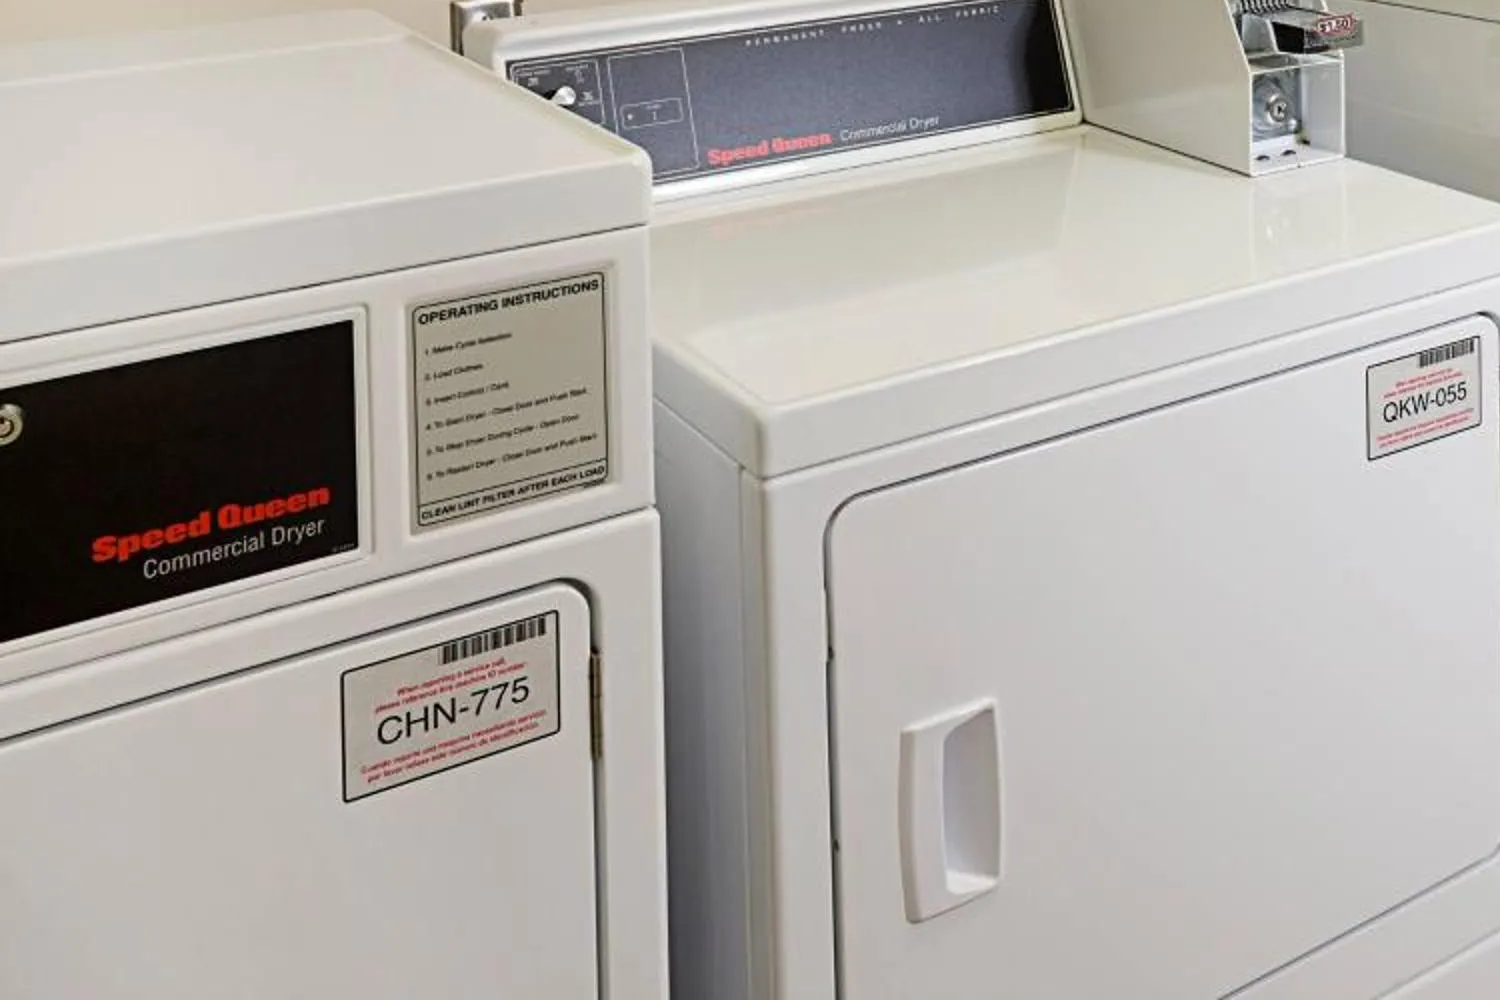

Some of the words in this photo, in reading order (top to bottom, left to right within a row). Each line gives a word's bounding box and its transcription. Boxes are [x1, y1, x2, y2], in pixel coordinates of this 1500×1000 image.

[707, 139, 769, 167] Speed
[771, 132, 833, 153] Queen
[909, 115, 940, 133] Dryer
[418, 299, 499, 325] OPERATING
[502, 279, 599, 309] INSTRUCTIONS
[1383, 381, 1467, 423] QKW-055
[421, 504, 457, 520] CLEAN
[458, 498, 480, 511] LINT
[482, 488, 515, 504] FILTER
[517, 479, 549, 495] AFTER
[551, 472, 577, 487] EACH
[579, 464, 606, 480] LOAD
[91, 510, 212, 562] Speed
[217, 486, 331, 529] Queen
[143, 530, 265, 580] Commercial
[271, 518, 326, 548] Dryer
[377, 676, 530, 745] CHN-775
